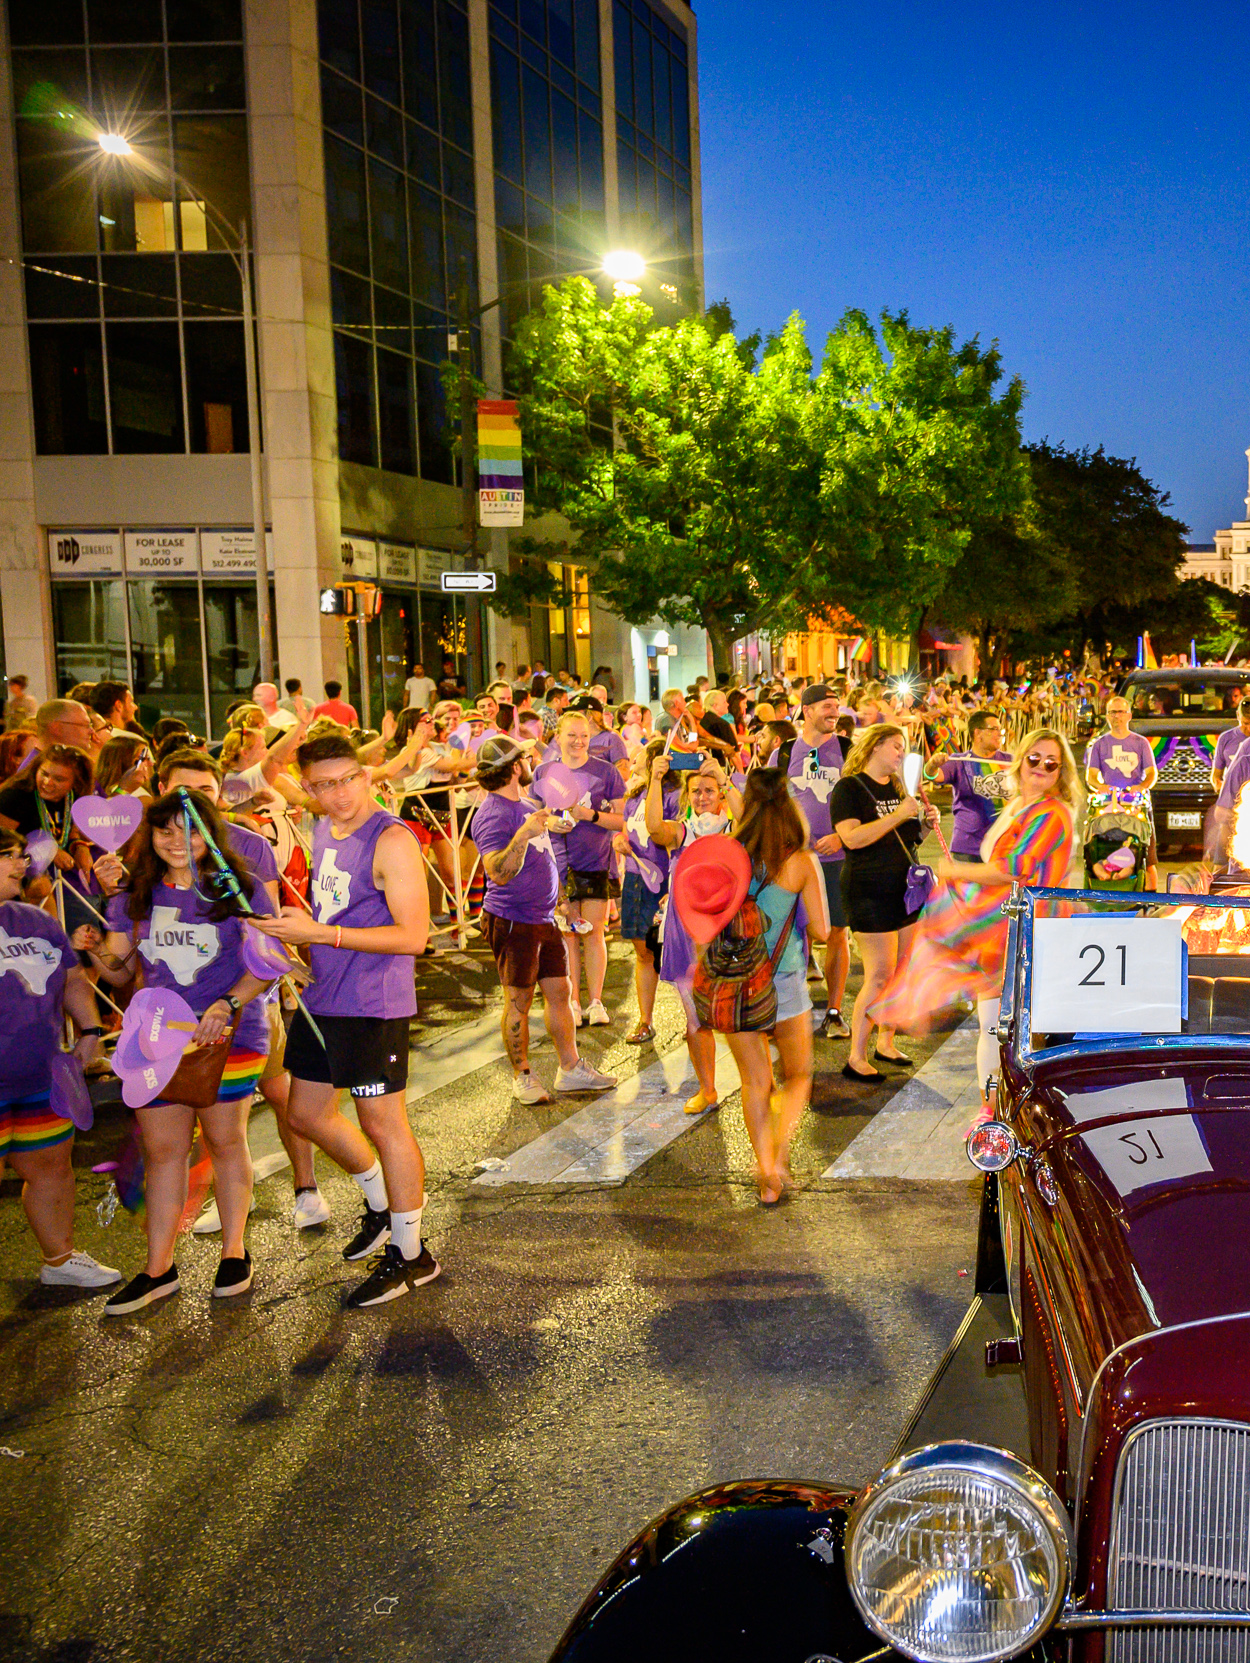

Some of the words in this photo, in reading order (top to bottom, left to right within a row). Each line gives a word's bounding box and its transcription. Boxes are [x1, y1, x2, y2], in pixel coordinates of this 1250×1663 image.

[481, 491, 522, 501] AUSTIN
[136, 538, 155, 547] FOR
[157, 538, 185, 547] LEASE
[138, 557, 171, 567] 30,000
[172, 557, 184, 566] SF
[806, 770, 828, 780] LOVE
[321, 874, 339, 893] LOVE
[155, 930, 195, 947] LOVE
[1, 941, 42, 959] LOVE
[1078, 944, 1127, 986] 21
